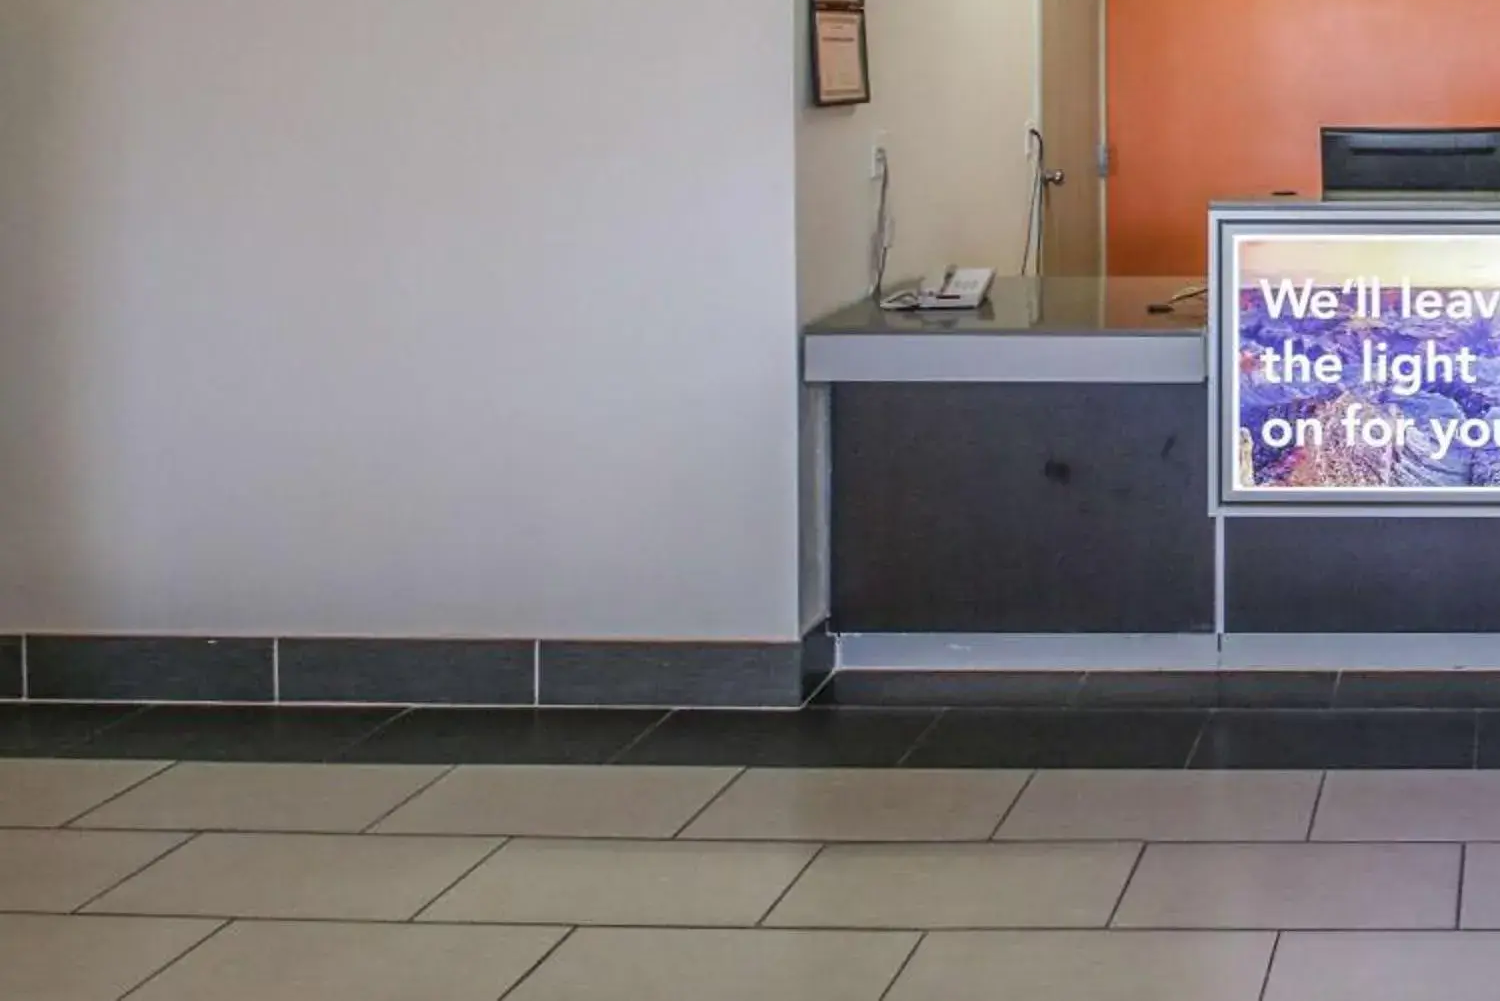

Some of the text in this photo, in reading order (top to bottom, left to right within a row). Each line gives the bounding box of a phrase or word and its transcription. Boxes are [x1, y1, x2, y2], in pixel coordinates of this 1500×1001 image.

[1259, 275, 1381, 320] We'll
[1260, 338, 1478, 396] the light
[1261, 418, 1323, 448] on
[1341, 403, 1415, 448] for
